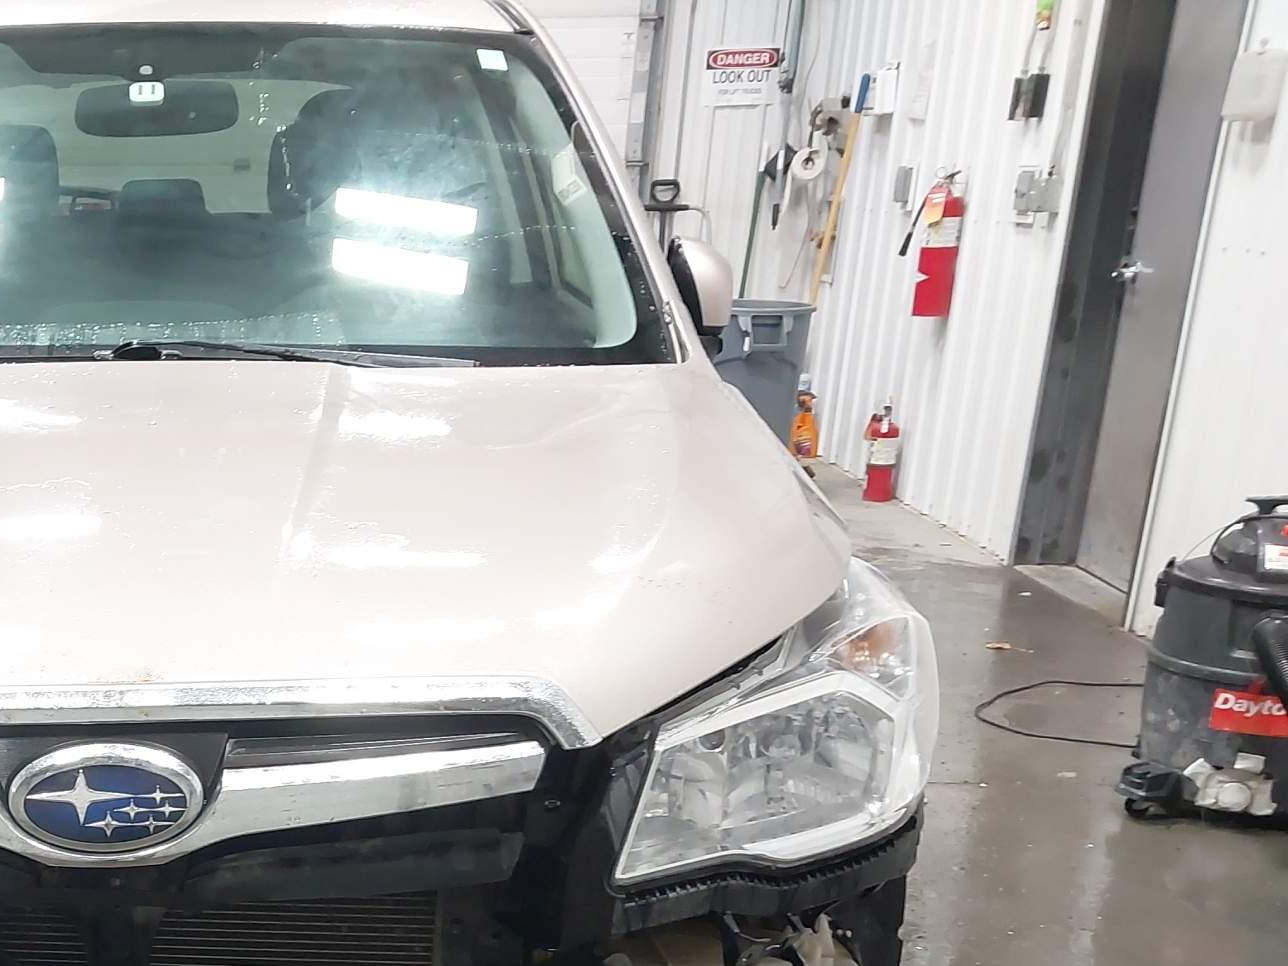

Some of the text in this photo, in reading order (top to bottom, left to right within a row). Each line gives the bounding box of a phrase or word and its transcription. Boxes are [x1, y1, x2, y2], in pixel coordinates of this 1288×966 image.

[716, 53, 770, 65] DANGER
[712, 70, 770, 83] LOOK OUT
[1213, 692, 1287, 717] Dayto
